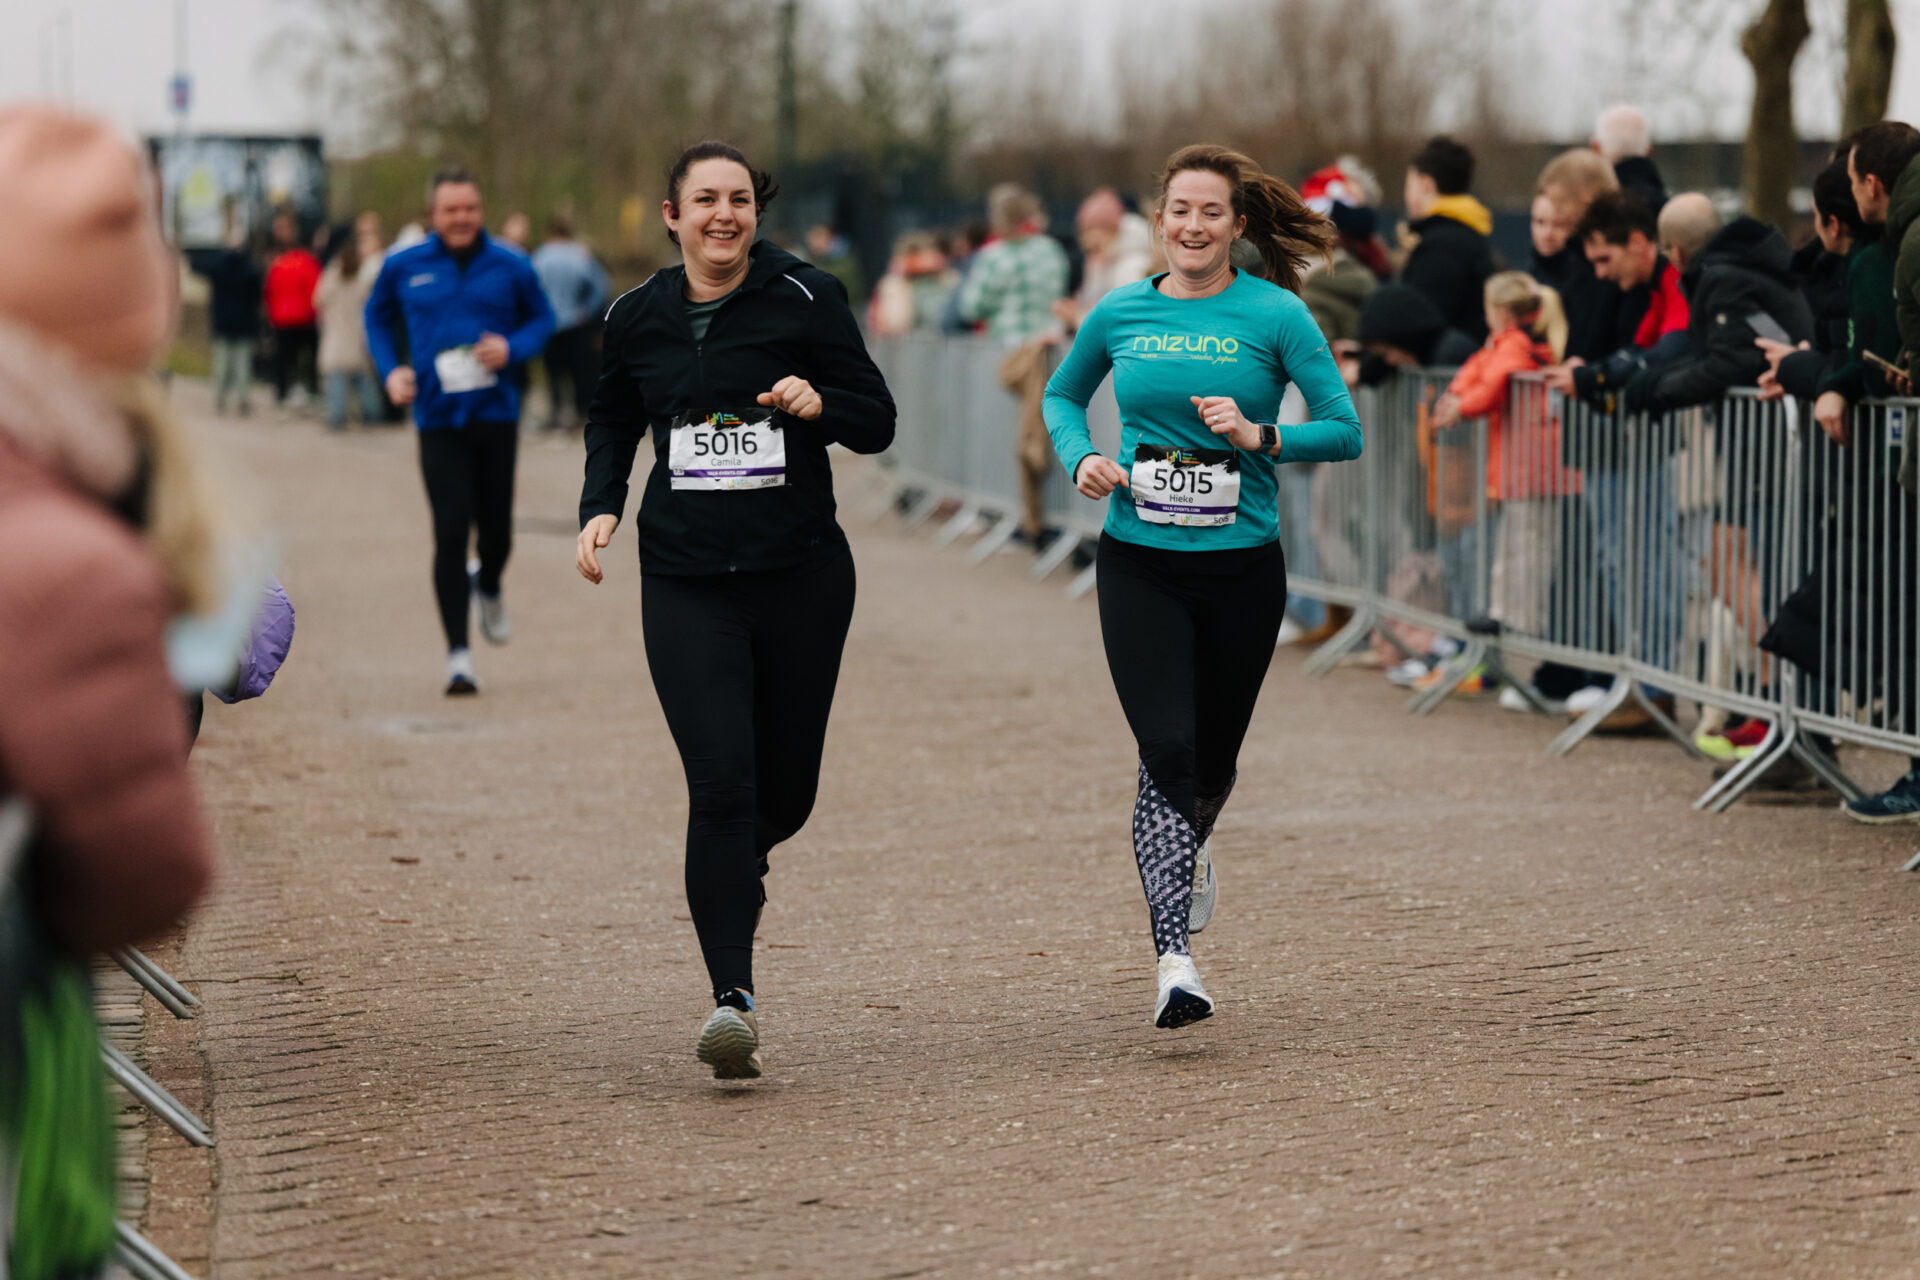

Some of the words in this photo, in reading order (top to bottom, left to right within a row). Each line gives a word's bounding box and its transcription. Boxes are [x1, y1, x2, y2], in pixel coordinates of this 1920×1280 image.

[1132, 333, 1238, 354] mizuno
[694, 431, 758, 456] 5016
[710, 458, 742, 467] Camila
[760, 477, 778, 486] 5016
[1153, 468, 1213, 494] 5015
[1169, 494, 1194, 503] Hieke
[1213, 515, 1229, 524] 5015
